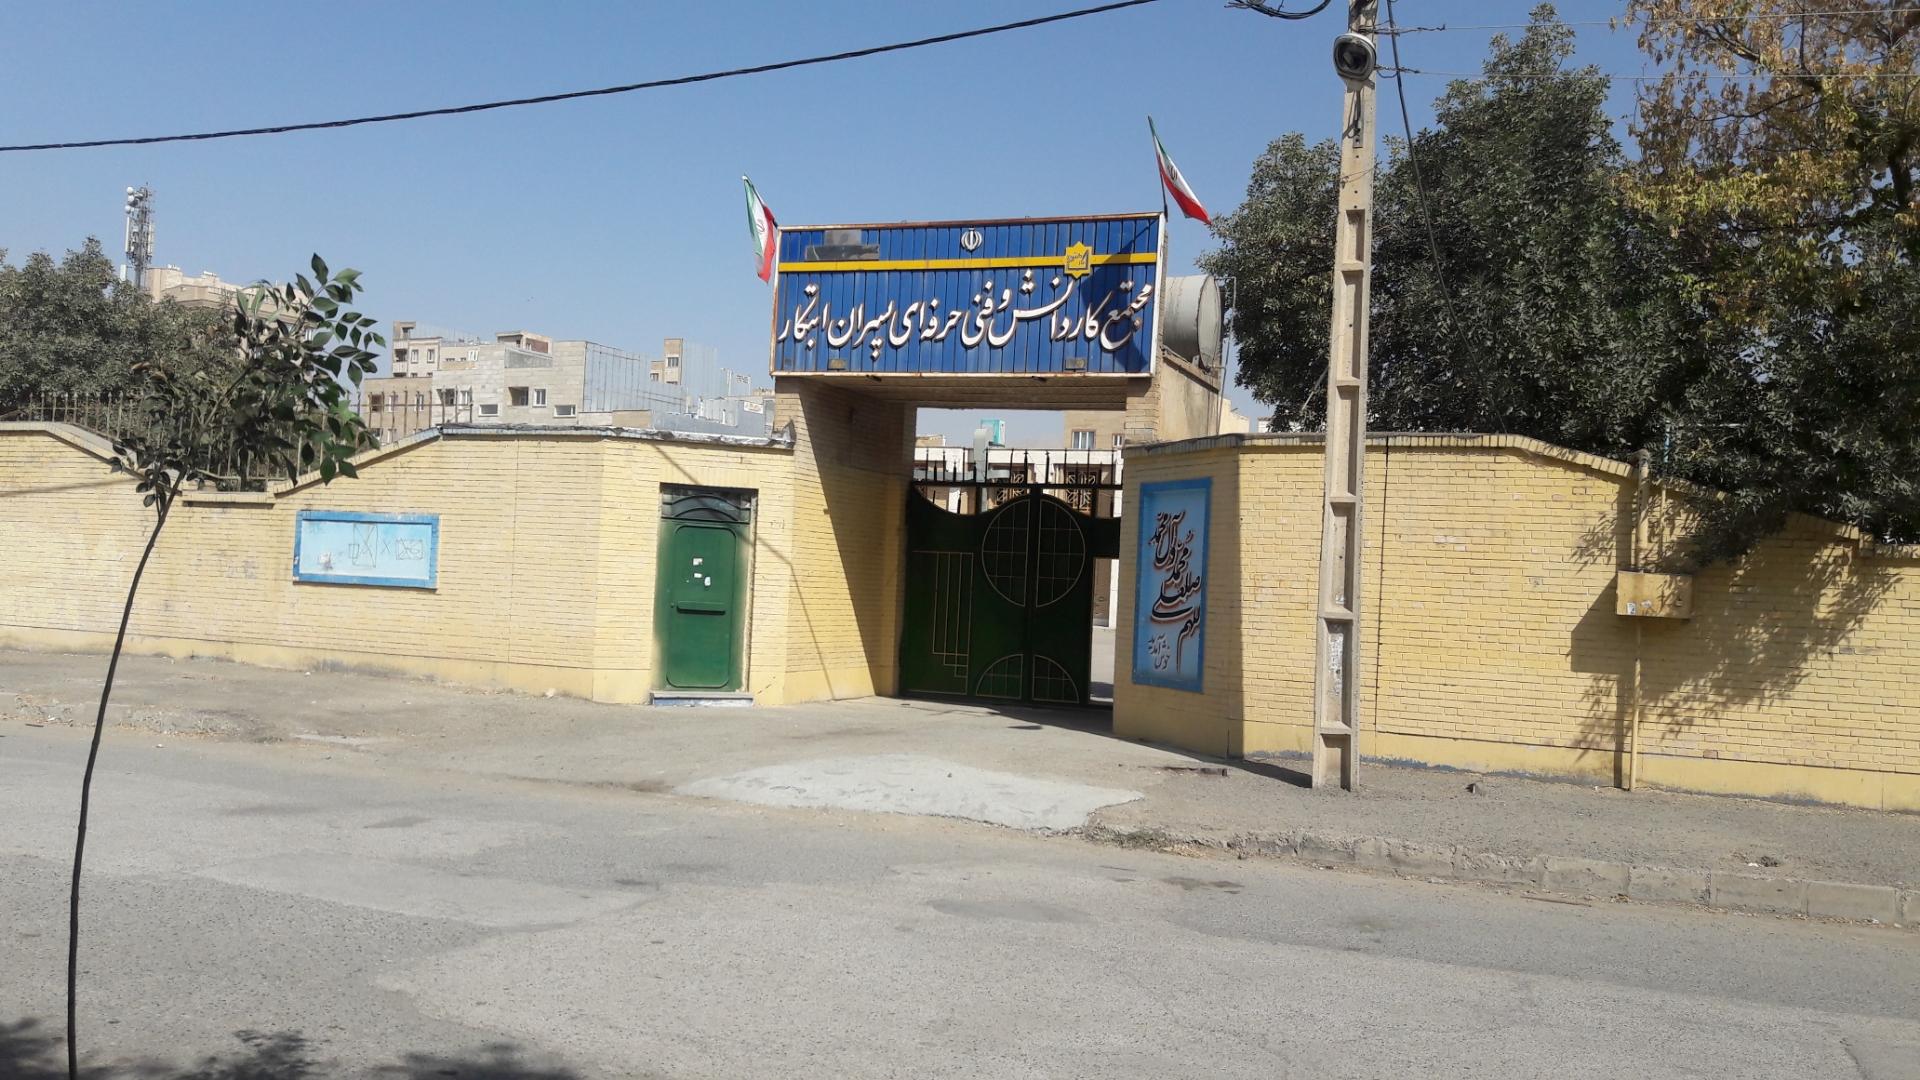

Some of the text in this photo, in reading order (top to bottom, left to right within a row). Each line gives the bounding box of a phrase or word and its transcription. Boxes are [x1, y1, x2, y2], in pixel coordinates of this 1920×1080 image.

[777, 283, 831, 349] ابتکار
[827, 300, 895, 361] پسران
[961, 280, 994, 348] فنی
[988, 268, 1113, 347] کاردانش
[998, 288, 1012, 310] و
[1100, 280, 1153, 350] مجتمع
[1175, 604, 1201, 674] للهم
